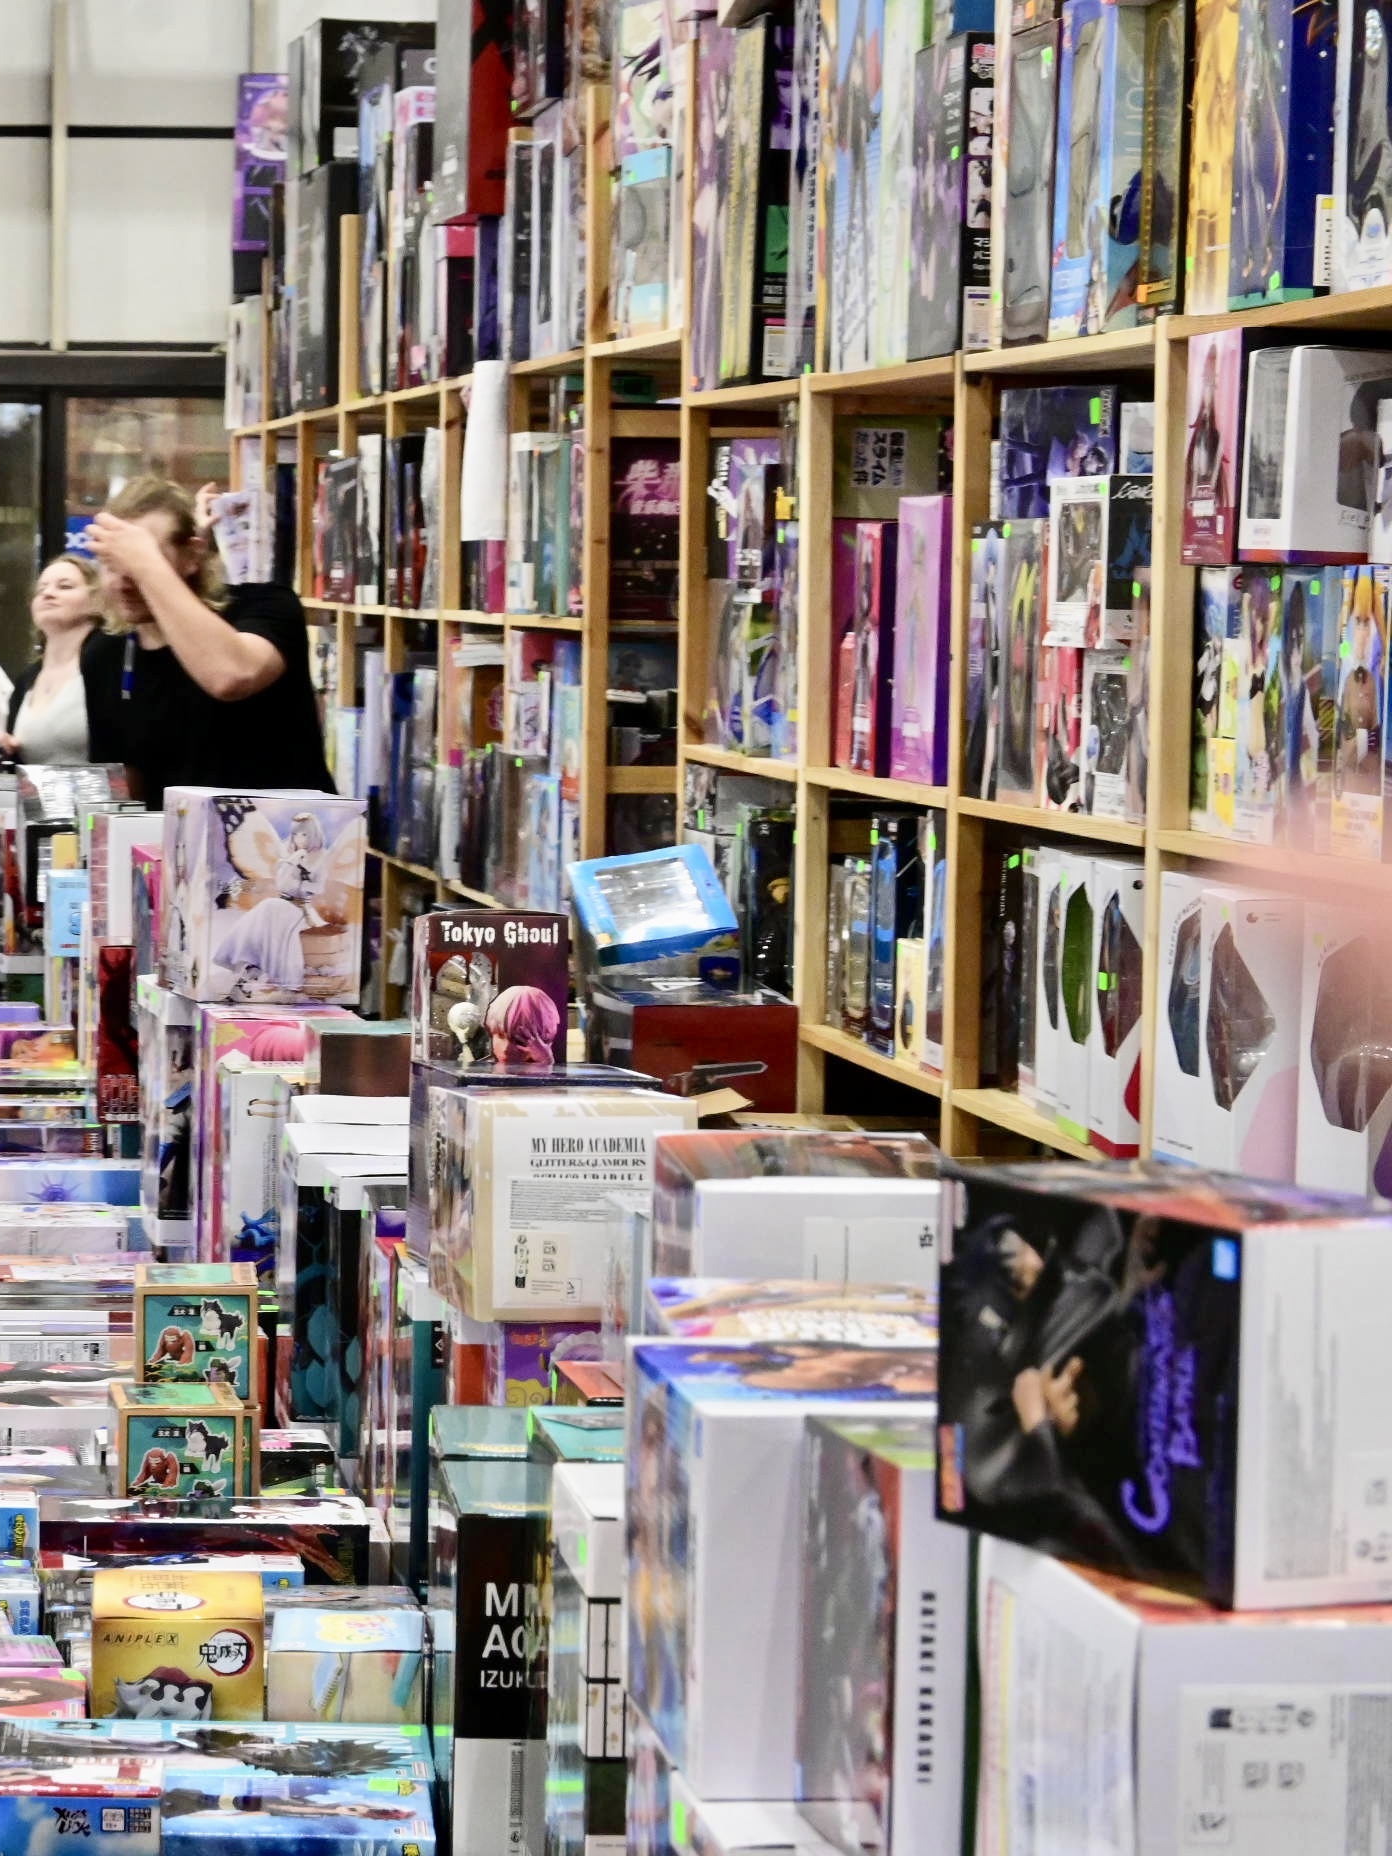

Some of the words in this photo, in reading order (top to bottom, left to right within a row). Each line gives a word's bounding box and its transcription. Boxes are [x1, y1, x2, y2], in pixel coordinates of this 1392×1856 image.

[441, 921, 495, 947] Tokyo
[504, 921, 559, 946] Ghoul
[531, 1137, 548, 1153] MY
[552, 1137, 584, 1153] HERO
[588, 1137, 646, 1153] ACADEMIA
[104, 1632, 178, 1646] ANIPLEX
[917, 1687, 934, 1784] KAKASHI
